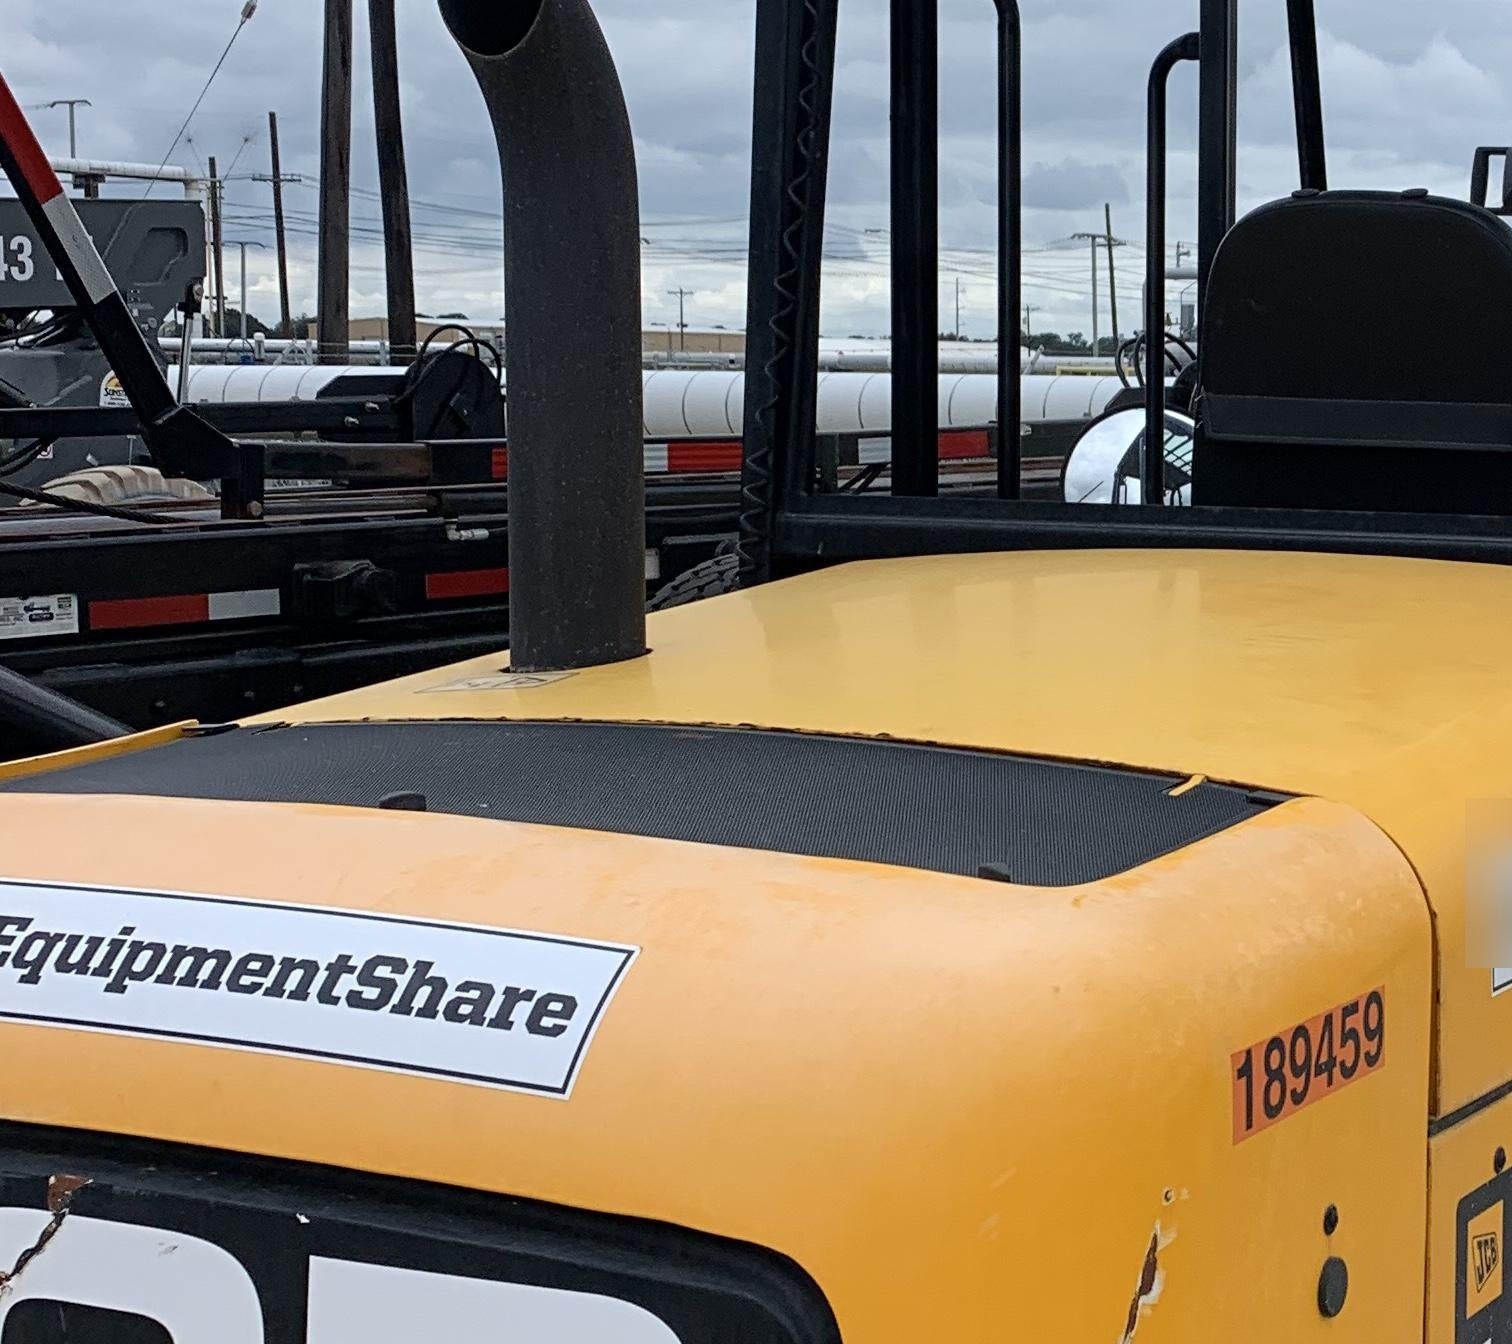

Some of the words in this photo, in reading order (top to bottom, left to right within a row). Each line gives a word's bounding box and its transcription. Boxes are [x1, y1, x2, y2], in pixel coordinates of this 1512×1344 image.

[0, 915, 578, 1039] EquipmentShare
[1236, 991, 1385, 1132] 189459
[1477, 1236, 1497, 1286] JCB
